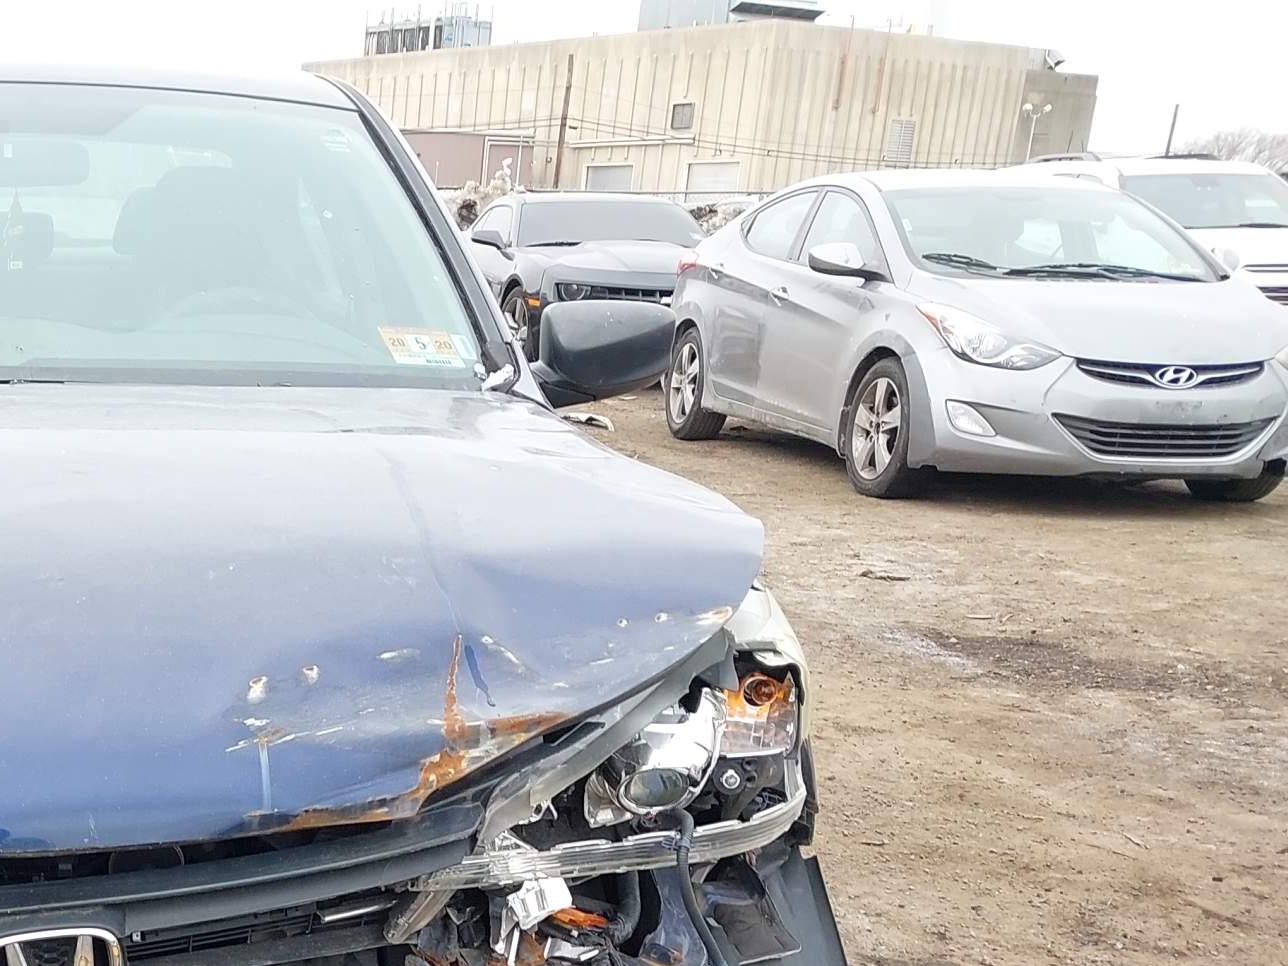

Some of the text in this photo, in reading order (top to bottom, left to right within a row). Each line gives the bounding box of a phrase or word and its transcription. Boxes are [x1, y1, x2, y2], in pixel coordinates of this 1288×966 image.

[388, 337, 453, 350] 20 5 20
